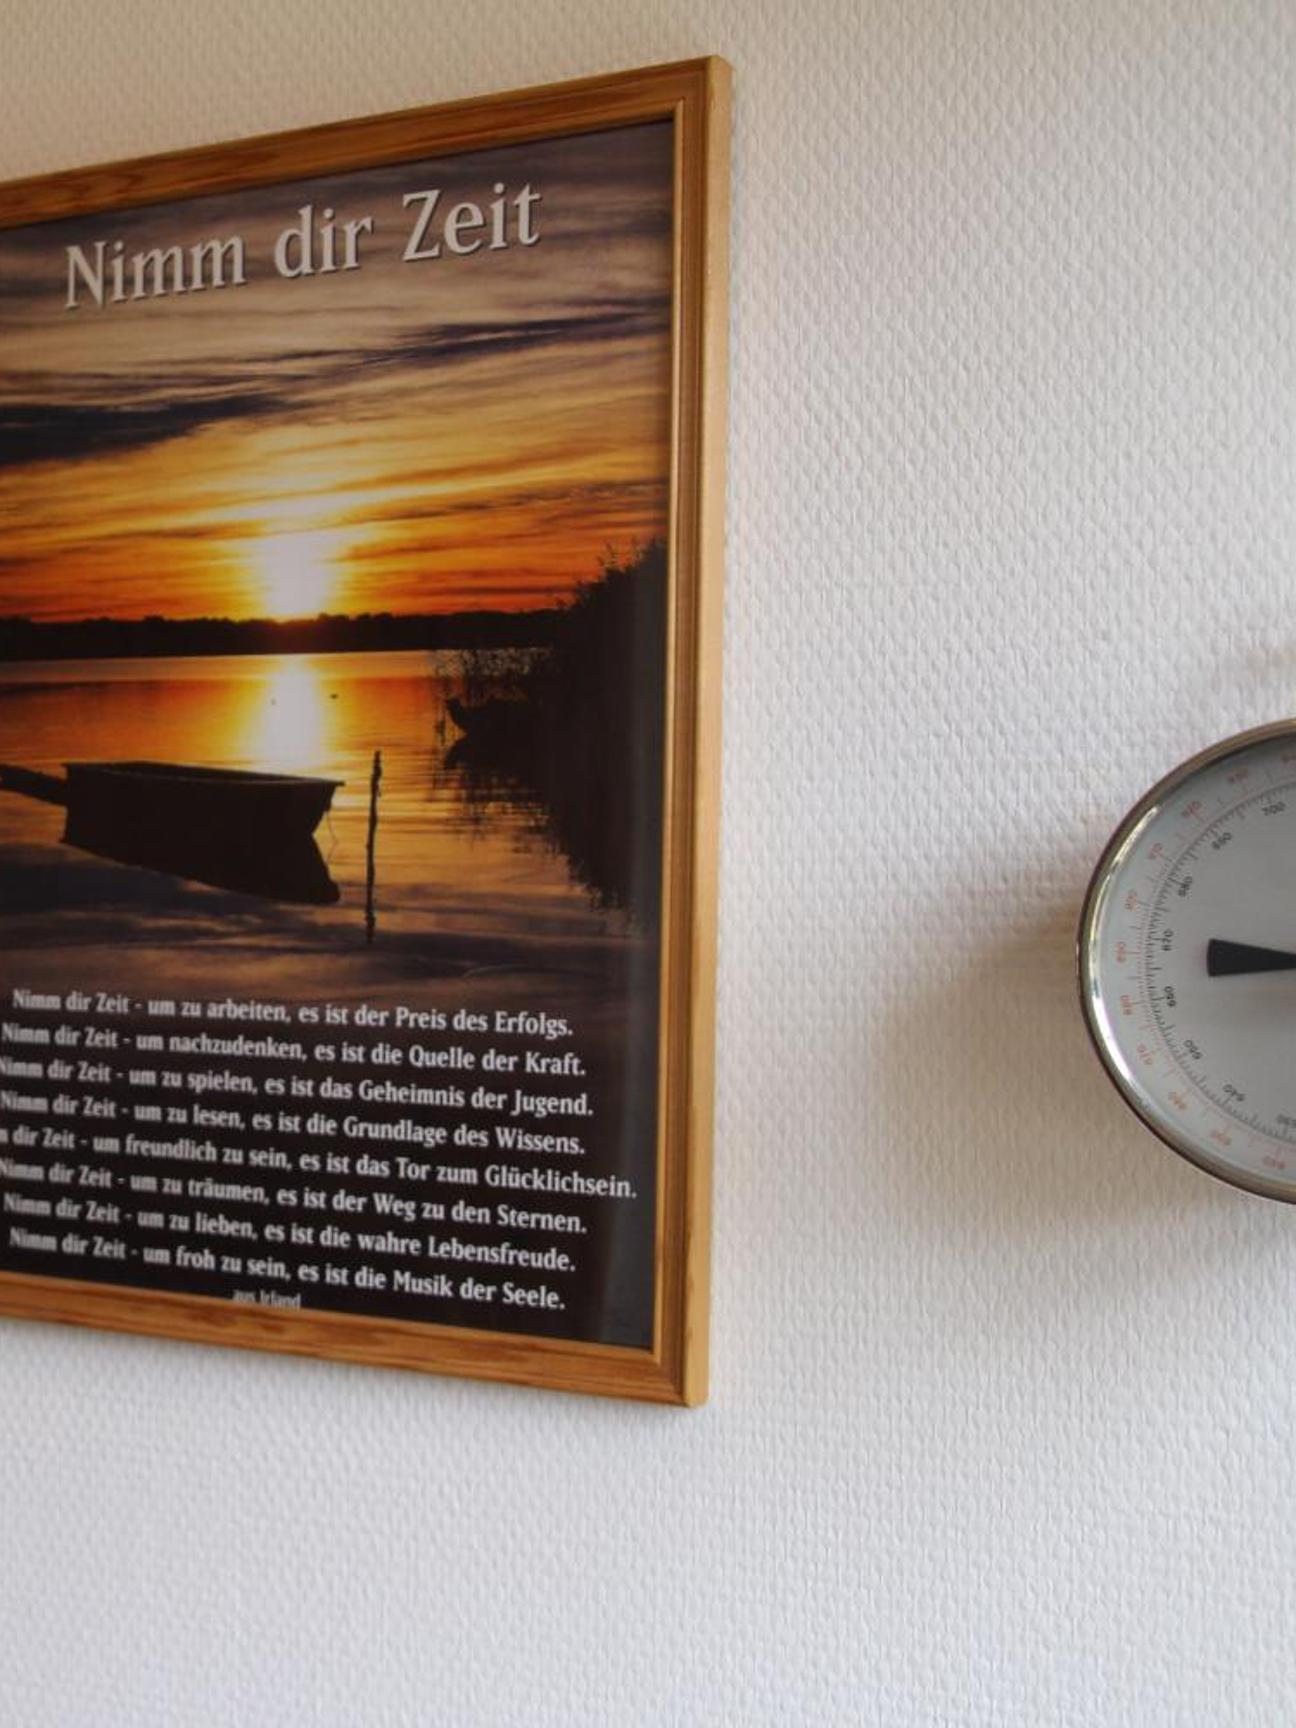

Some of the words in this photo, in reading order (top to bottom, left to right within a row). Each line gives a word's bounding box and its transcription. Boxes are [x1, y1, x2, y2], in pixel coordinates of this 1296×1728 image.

[64, 234, 247, 309] Nimm
[274, 205, 374, 279] dir
[401, 182, 542, 261] Zeit
[1, 1022, 50, 1044] Nimm
[54, 1025, 81, 1046] dir
[85, 1026, 118, 1048] Zeit
[136, 1035, 164, 1051] um
[169, 1032, 308, 1062] nachzudenken,
[313, 1044, 336, 1061] es
[341, 1041, 365, 1064] ist
[370, 1042, 403, 1065] die
[408, 1044, 476, 1070] Quelle
[481, 1048, 519, 1072] der
[525, 1050, 586, 1076] Kraft.
[13, 988, 61, 1010] Nimm
[65, 990, 92, 1011] dir
[96, 992, 130, 1014] Zeit
[147, 1000, 176, 1016] um
[181, 1001, 202, 1017] zu
[206, 997, 292, 1023] arbeiten,
[297, 1006, 320, 1023] es
[325, 1003, 349, 1025] ist
[353, 1003, 390, 1027] der
[395, 1005, 447, 1030] Preis
[452, 1008, 489, 1032] des
[494, 1010, 574, 1041] Erfolgs.
[0, 1090, 49, 1112] Nimm
[52, 1093, 79, 1115] dir
[83, 1096, 116, 1118] Zeit
[134, 1105, 162, 1121] um
[167, 1107, 188, 1124] zu
[193, 1103, 246, 1130] lesen,
[251, 1113, 273, 1131] es
[277, 1111, 301, 1133] ist
[306, 1112, 338, 1136] die
[342, 1115, 448, 1148] Grundlage
[453, 1123, 489, 1148] des
[495, 1126, 585, 1155] Wissens.
[47, 1059, 74, 1080] dir
[77, 1061, 111, 1083] Zeit
[128, 1070, 157, 1086] um
[162, 1071, 182, 1088] zu
[187, 1070, 258, 1095] spielen,
[264, 1078, 286, 1095] es
[290, 1075, 314, 1097] ist
[319, 1076, 354, 1100] das
[358, 1079, 466, 1108] Geheimnis
[470, 1086, 508, 1110] der
[510, 1089, 594, 1118] Jugend.
[12, 1125, 39, 1146] dir
[42, 1127, 75, 1149] Zeit
[93, 1137, 120, 1153] um
[125, 1133, 217, 1162] freundlich
[222, 1147, 244, 1165] zu
[248, 1147, 293, 1171] sein,
[298, 1153, 321, 1172] es
[326, 1152, 350, 1174] ist
[355, 1153, 391, 1178] das
[395, 1156, 431, 1181] Tor
[436, 1165, 479, 1185] zum
[484, 1164, 637, 1199] Glücklichsein.
[48, 1162, 75, 1183] dir
[79, 1165, 112, 1188] Zeit
[130, 1175, 158, 1192] um
[162, 1178, 183, 1195] zu
[187, 1177, 270, 1205] träumen,
[276, 1188, 298, 1207] es
[303, 1186, 327, 1209] ist
[331, 1188, 368, 1213] der
[372, 1192, 416, 1222] Weg
[421, 1202, 445, 1220] zu
[450, 1199, 491, 1225] den
[496, 1203, 587, 1234] Sternen.
[4, 1192, 51, 1216] Nimm
[55, 1197, 82, 1219] dir
[86, 1200, 120, 1223] Zeit
[137, 1211, 165, 1228] um
[169, 1214, 190, 1231] zu
[195, 1211, 258, 1240] lieben,
[263, 1224, 286, 1242] es
[290, 1222, 314, 1245] ist
[319, 1224, 351, 1249] die
[357, 1230, 422, 1256] wahre
[428, 1235, 576, 1272] Lebensfreude.
[10, 1227, 58, 1251] Nimm
[61, 1233, 89, 1255] dir
[93, 1236, 126, 1259] Zeit
[143, 1247, 171, 1265] um
[175, 1245, 216, 1270] froh
[221, 1255, 242, 1273] zu
[246, 1256, 291, 1281] sein,
[297, 1264, 320, 1283] es
[325, 1263, 349, 1286] ist
[354, 1265, 387, 1290] die
[393, 1269, 454, 1298] Musik
[459, 1277, 497, 1302] der
[502, 1281, 566, 1310] Seele.
